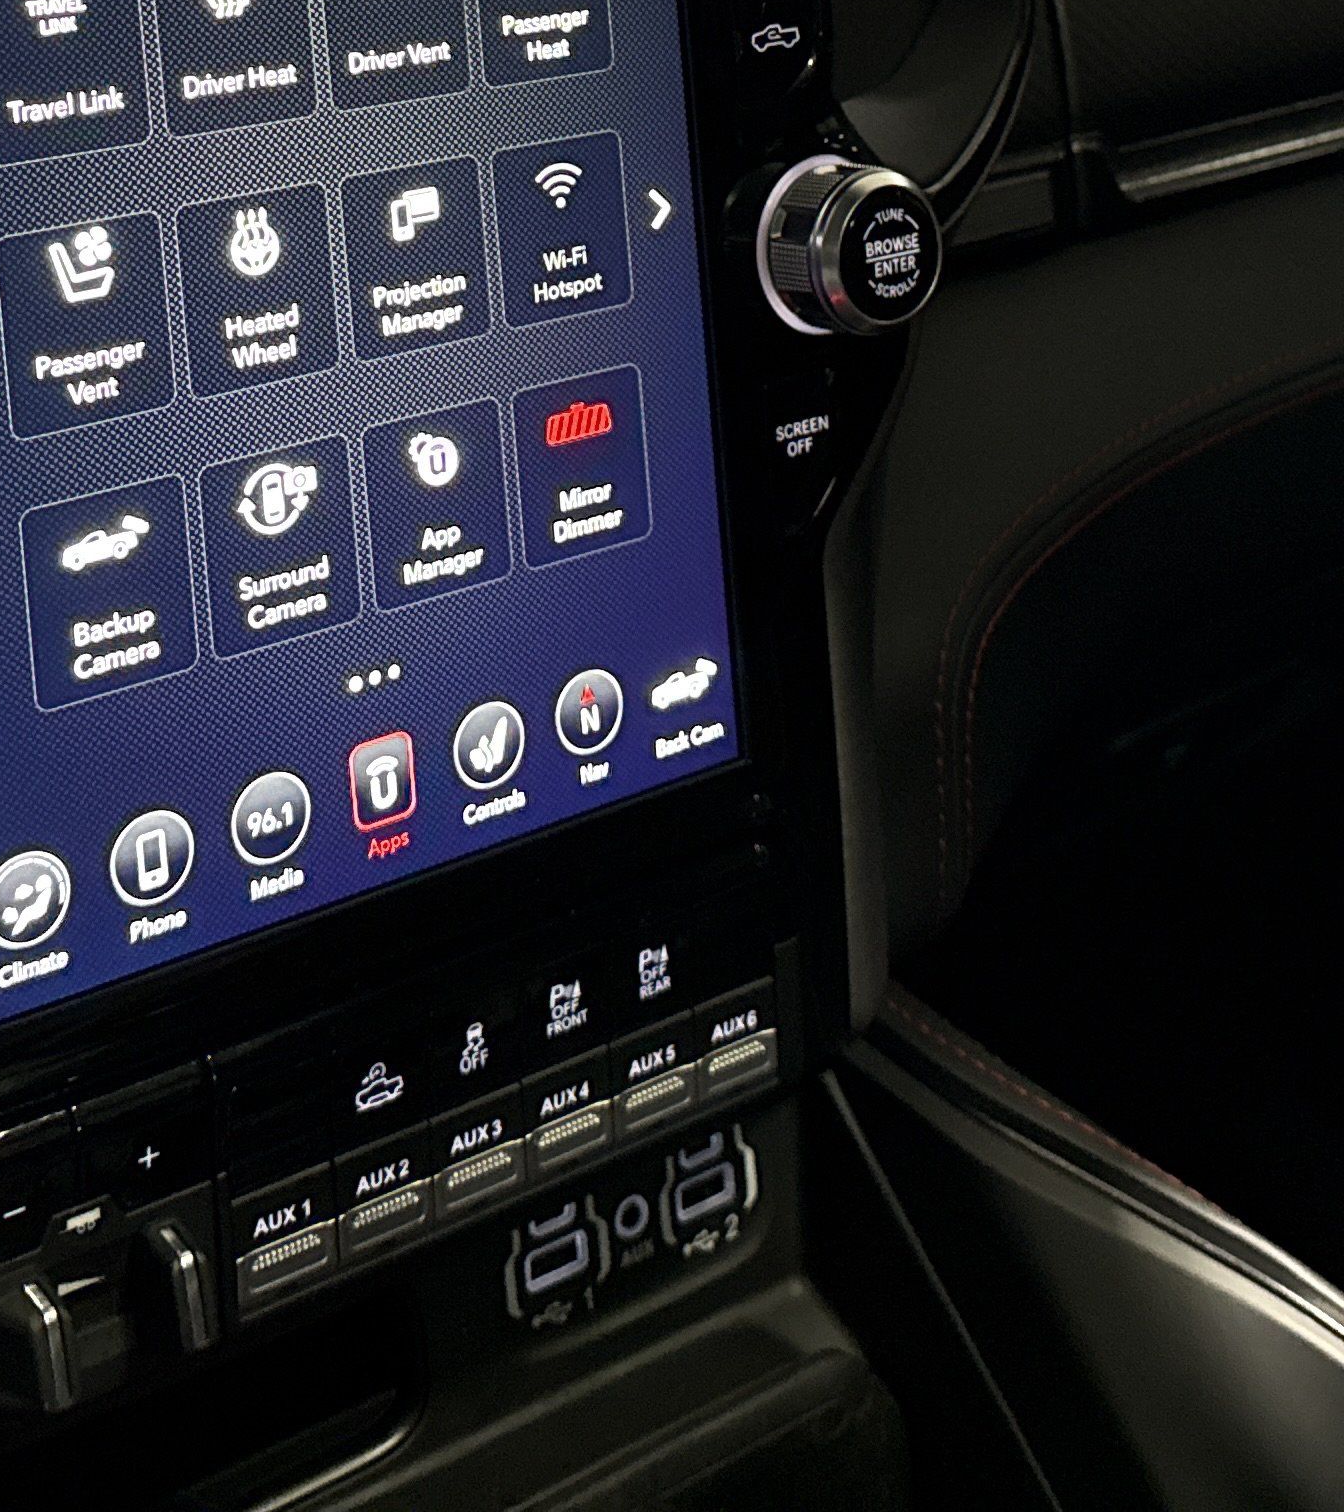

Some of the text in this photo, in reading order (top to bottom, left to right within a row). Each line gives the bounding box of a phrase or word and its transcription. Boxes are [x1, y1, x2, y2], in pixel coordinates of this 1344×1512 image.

[501, 9, 590, 37] Passenger
[347, 41, 452, 76] Driver Vent
[526, 38, 571, 62] Heat
[182, 63, 298, 100] Driver Heat
[5, 85, 126, 124] Travel Link
[874, 207, 905, 225] TUNE
[542, 244, 588, 272] Wi-Fi
[865, 233, 919, 256] BROWSE
[874, 254, 920, 279] ENTER
[372, 274, 467, 309] Projection
[533, 272, 604, 304] Hotspot
[874, 276, 917, 298] SCROLL
[224, 302, 300, 340] Heated
[381, 304, 464, 337] Manager
[34, 341, 146, 380] Passenger
[231, 333, 298, 370] Wheel
[66, 376, 120, 406] Vent
[775, 415, 829, 442] SCREEN
[786, 436, 813, 457] OFF
[559, 483, 612, 513] Mirror
[420, 525, 462, 551] App
[553, 509, 623, 544] Dimmer
[238, 554, 330, 602] Surround
[402, 548, 484, 586] Manager
[247, 593, 327, 630] Camera
[73, 610, 156, 648] Backup
[73, 640, 162, 680] Camera
[579, 703, 601, 735] N
[655, 722, 725, 759] Back Cam
[579, 761, 610, 786] Nav
[246, 801, 294, 838] 96.1
[462, 788, 526, 826] Controls
[367, 831, 410, 860] Apps
[250, 867, 305, 901] Media
[129, 910, 187, 945] Phone
[639, 975, 671, 999] REAR
[640, 963, 667, 984] OFF
[546, 1008, 588, 1036] FRONT
[551, 998, 579, 1020] OFF
[711, 1009, 757, 1042] AUX 6
[459, 1048, 489, 1075] OFF
[628, 1044, 676, 1078] AUX 5
[540, 1081, 590, 1116] AUX 4
[450, 1119, 503, 1155] AUX 3
[355, 1158, 410, 1196] AUX 2
[253, 1198, 311, 1238] AUX 1
